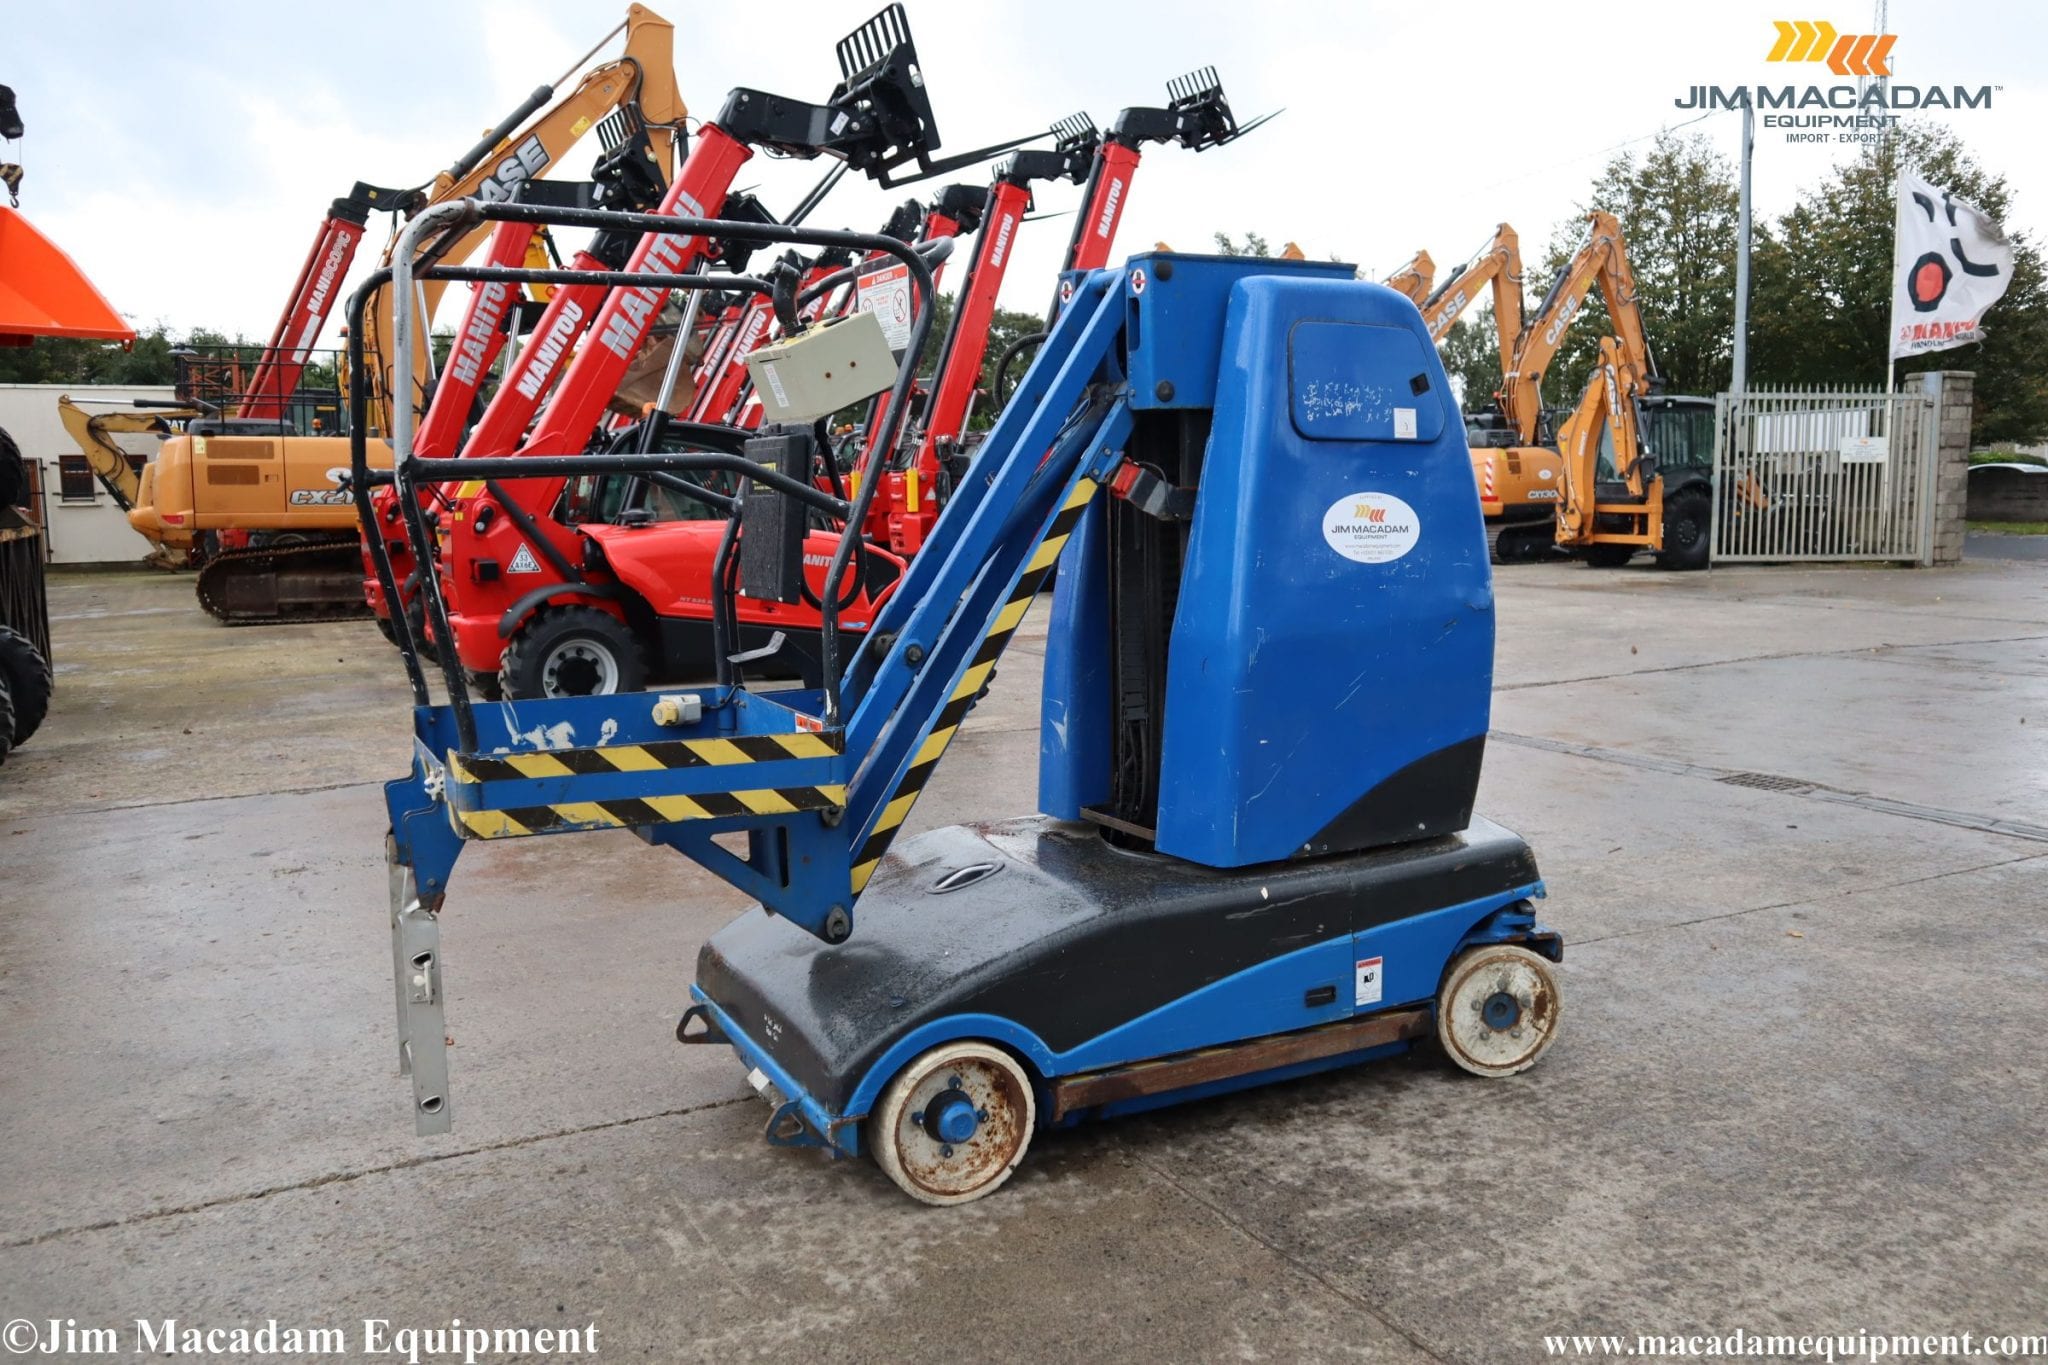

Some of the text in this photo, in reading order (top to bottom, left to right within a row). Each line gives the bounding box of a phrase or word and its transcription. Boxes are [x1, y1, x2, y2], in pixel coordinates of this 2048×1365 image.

[479, 134, 550, 202] ASE
[1097, 177, 1123, 239] MANITOU
[991, 212, 1014, 268] MANITOU
[733, 309, 768, 366] MANITOU
[1429, 290, 1467, 337] CASE
[1546, 294, 1577, 346] CASE
[516, 298, 584, 401] MANITOU
[1331, 525, 1409, 533] JIM MACADAM
